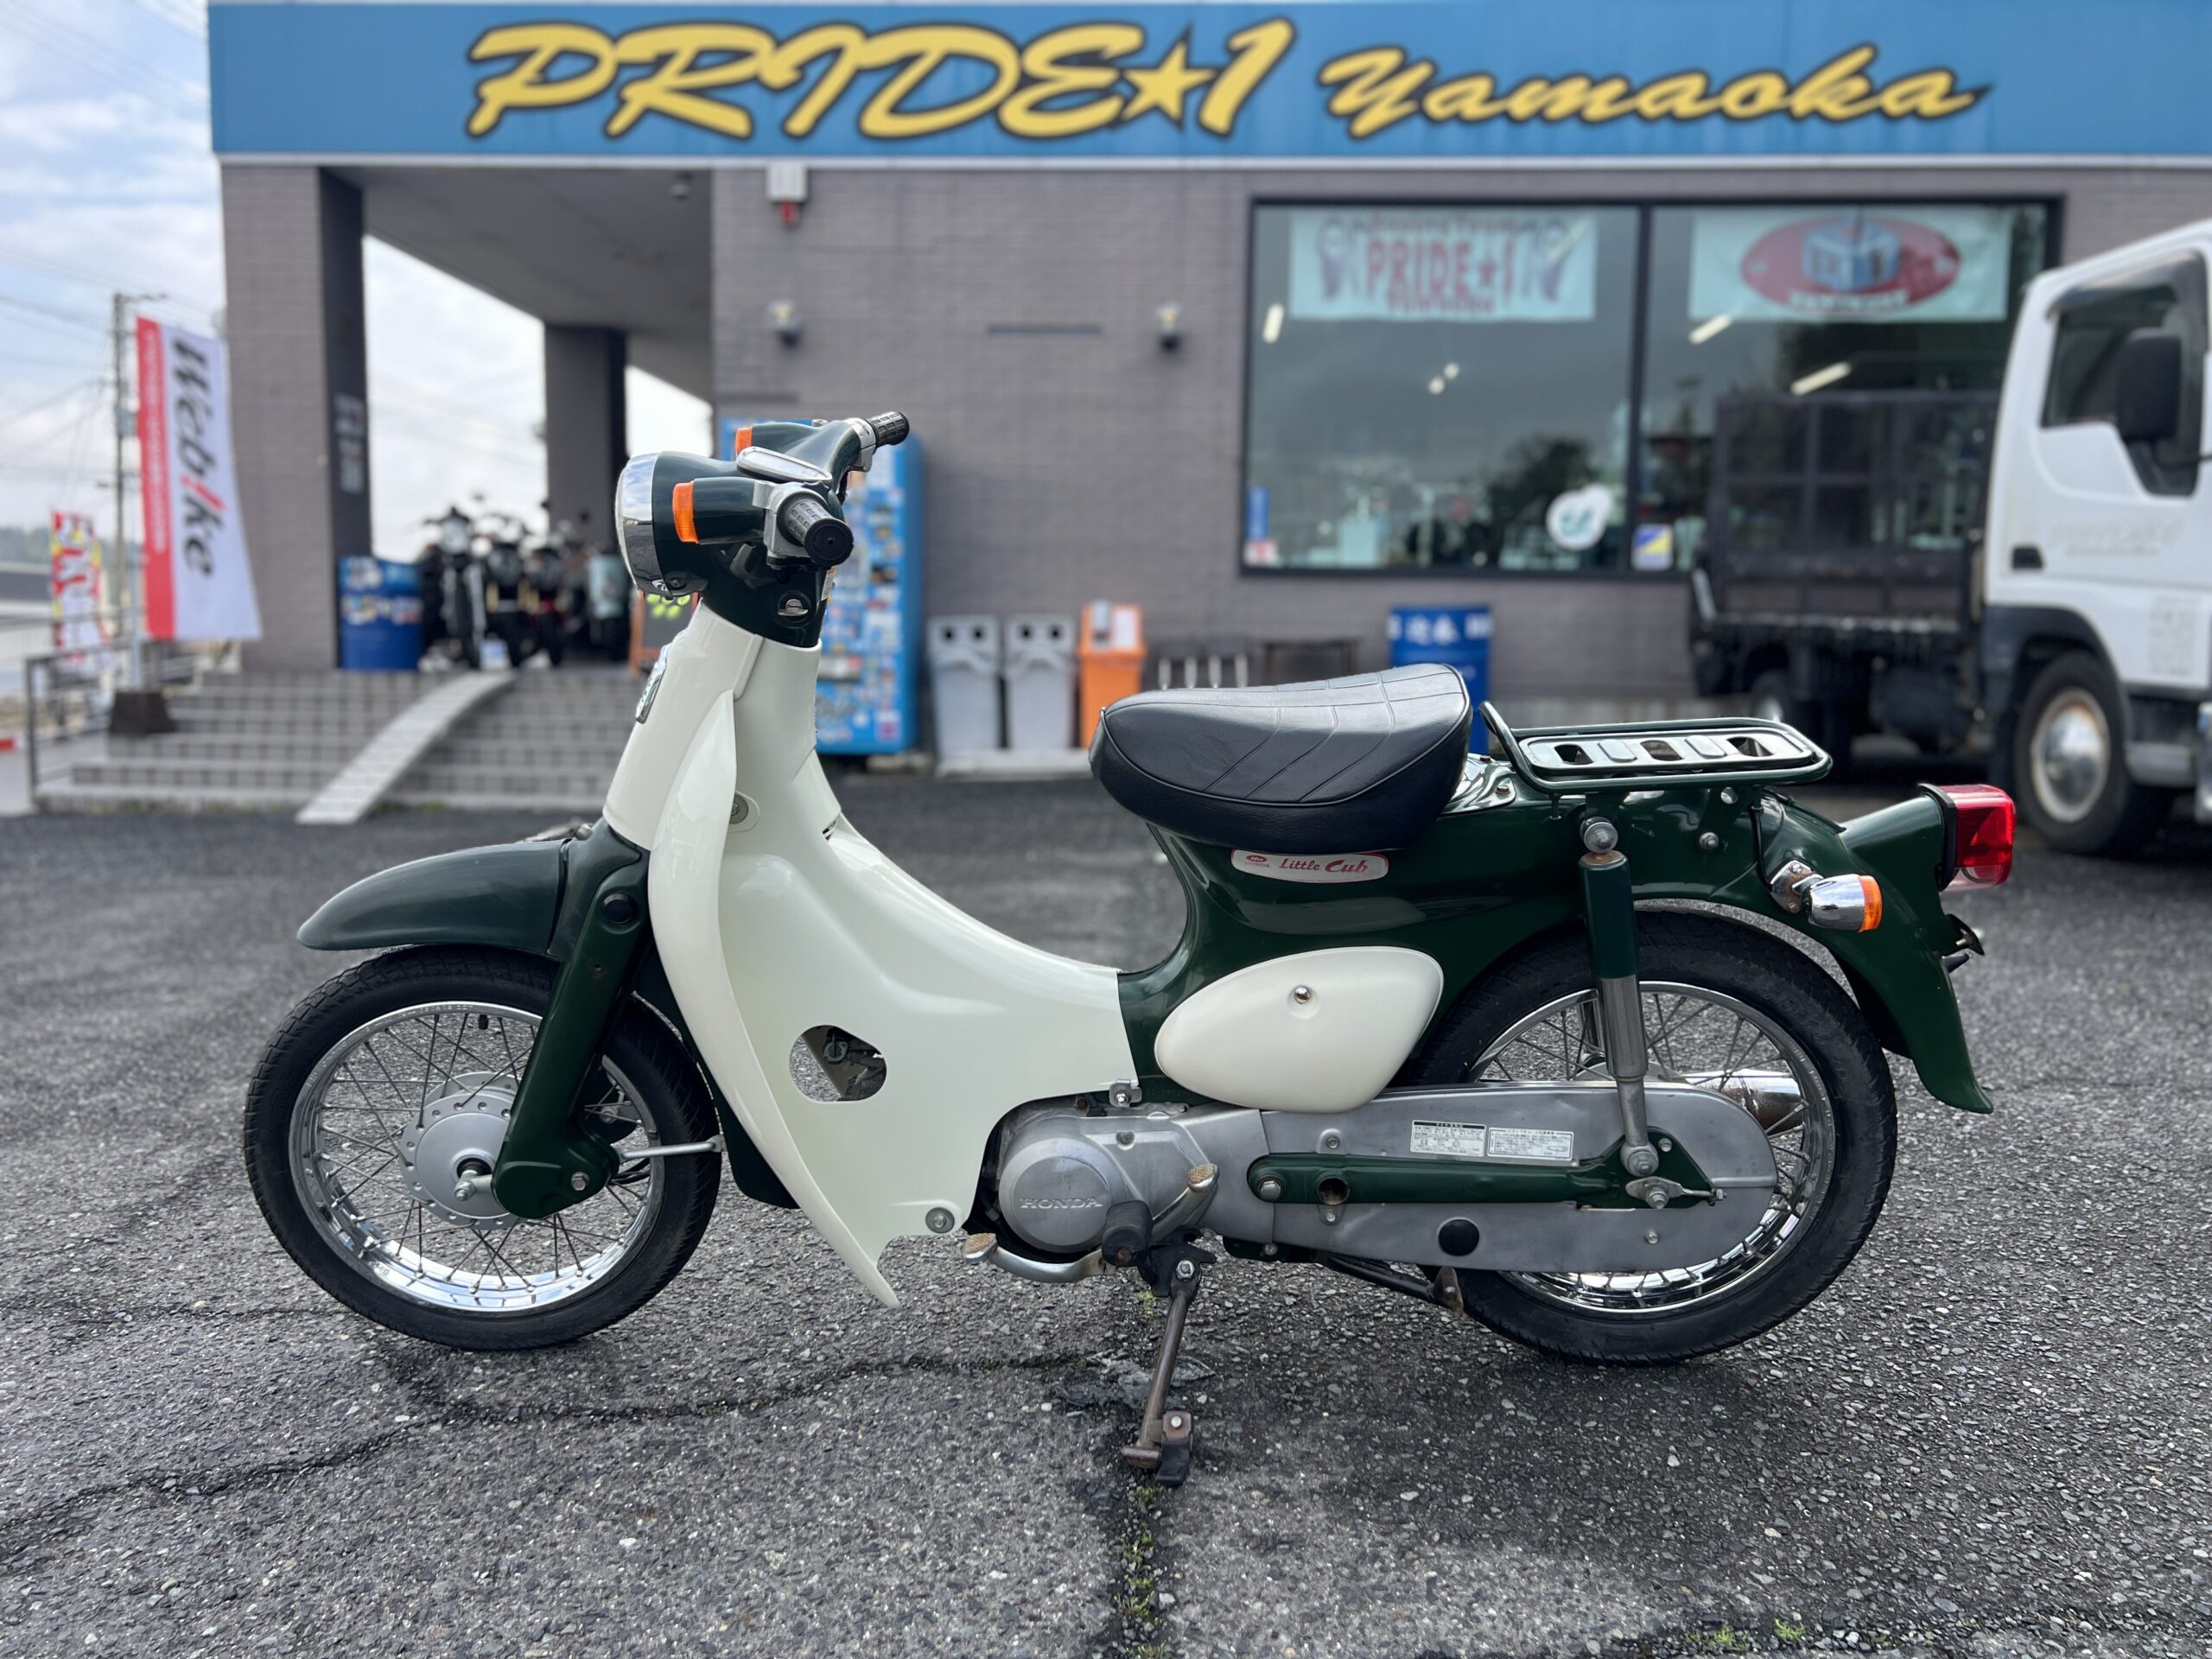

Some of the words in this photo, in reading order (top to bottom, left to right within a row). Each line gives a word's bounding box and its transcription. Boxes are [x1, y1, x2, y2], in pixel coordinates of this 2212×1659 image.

[1318, 42, 1994, 143] Yamaoka
[1279, 858, 1320, 871] Little
[1325, 859, 1369, 874] Cub
[1020, 1197, 1103, 1210] HONDA
